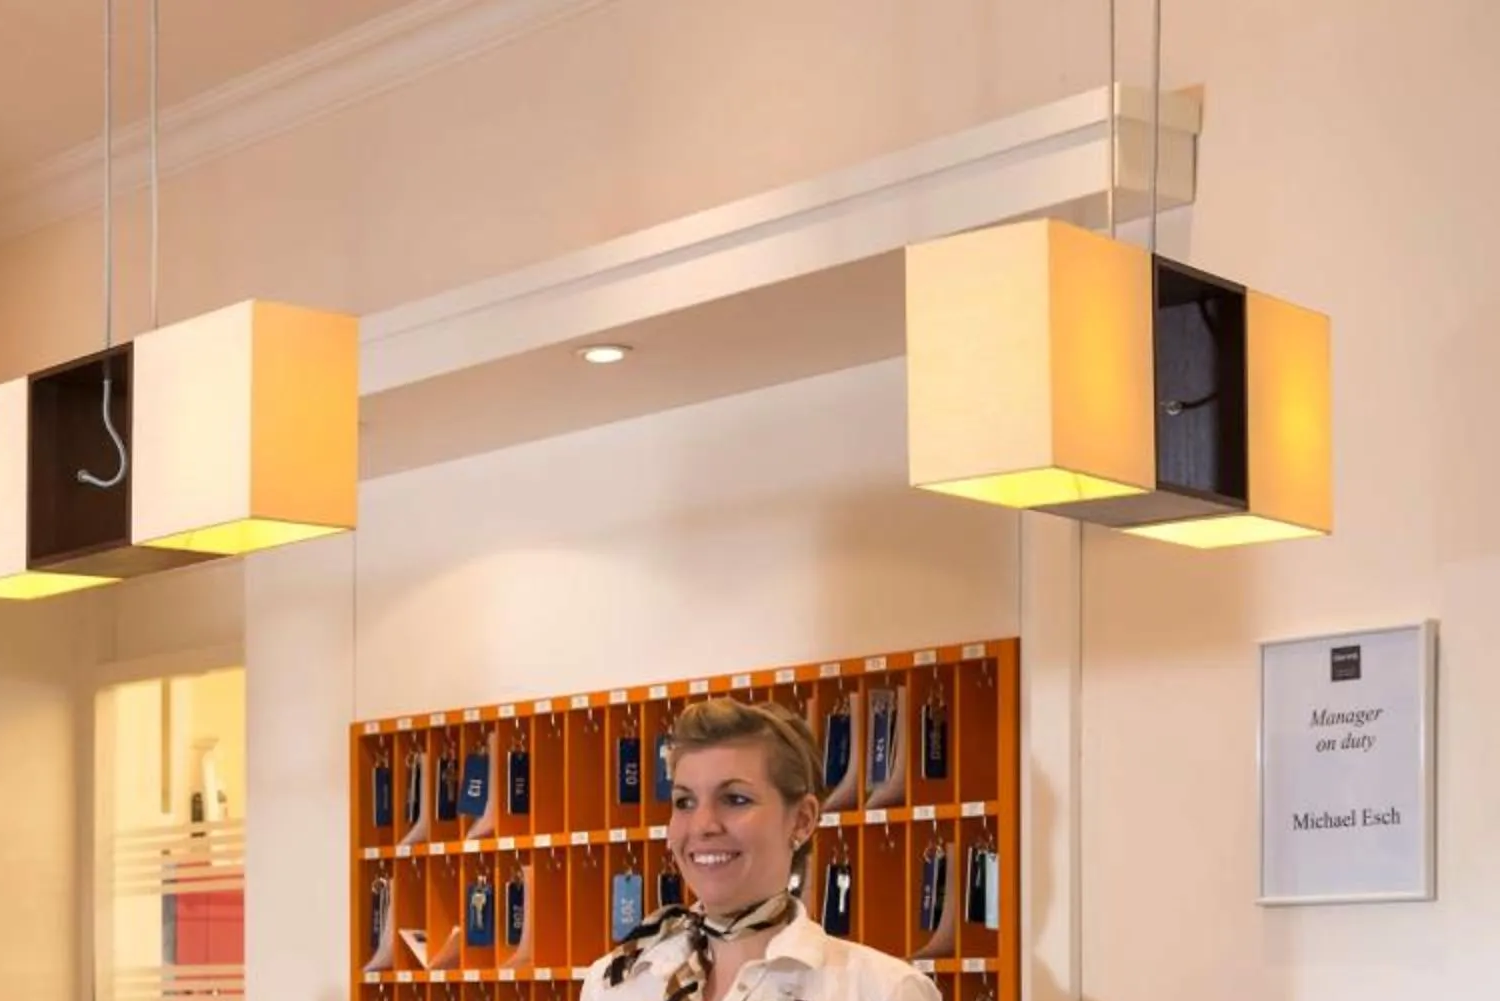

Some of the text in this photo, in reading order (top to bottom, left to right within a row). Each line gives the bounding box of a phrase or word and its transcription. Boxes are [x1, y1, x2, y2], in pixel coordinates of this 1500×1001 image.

[1310, 708, 1384, 728] Manager
[1315, 732, 1377, 753] on duty
[1293, 806, 1401, 831] Michael Esch
